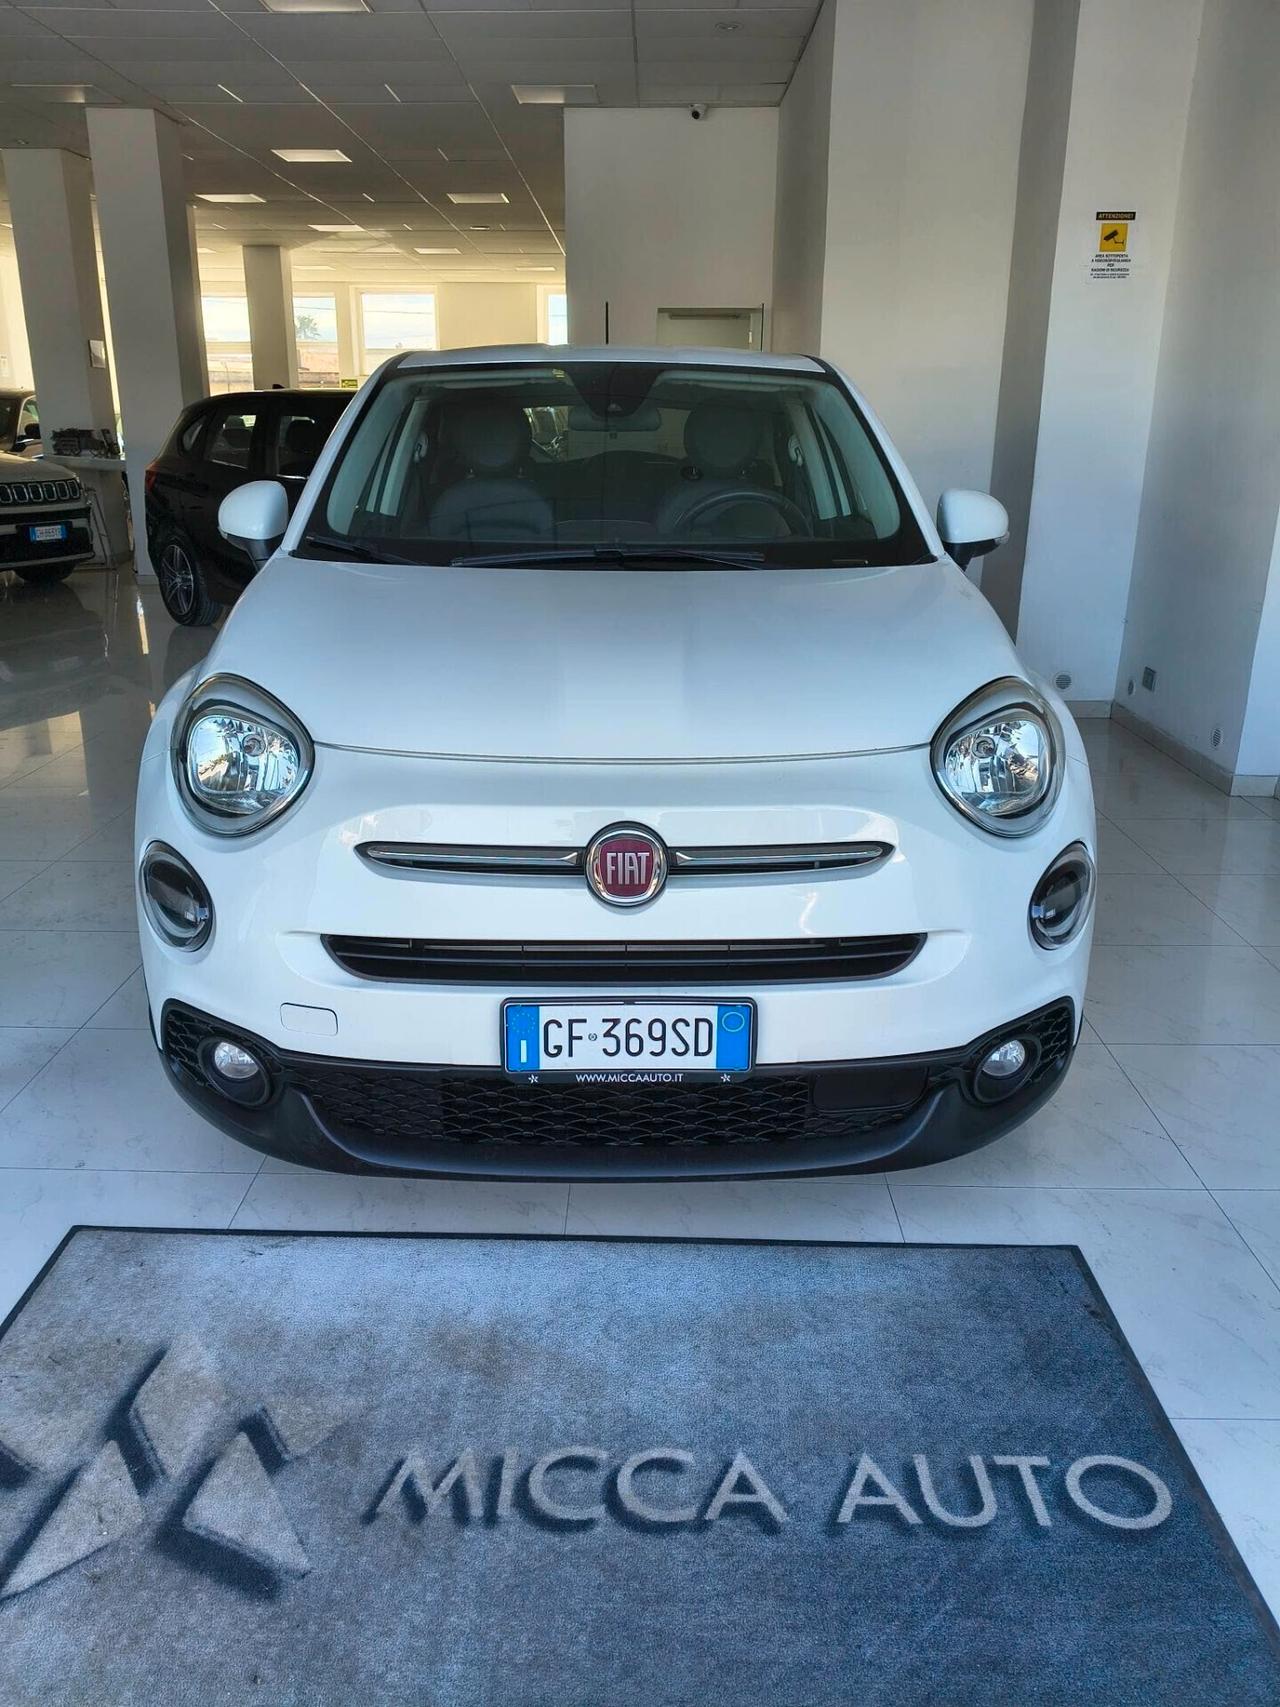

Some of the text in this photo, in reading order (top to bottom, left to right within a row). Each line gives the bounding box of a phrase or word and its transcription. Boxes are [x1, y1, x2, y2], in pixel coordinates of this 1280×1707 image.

[606, 852, 650, 885] FIAT
[575, 1073, 685, 1084] WWW.MICCAAUTO.IT
[374, 1446, 1173, 1530] MICCA AUTO
